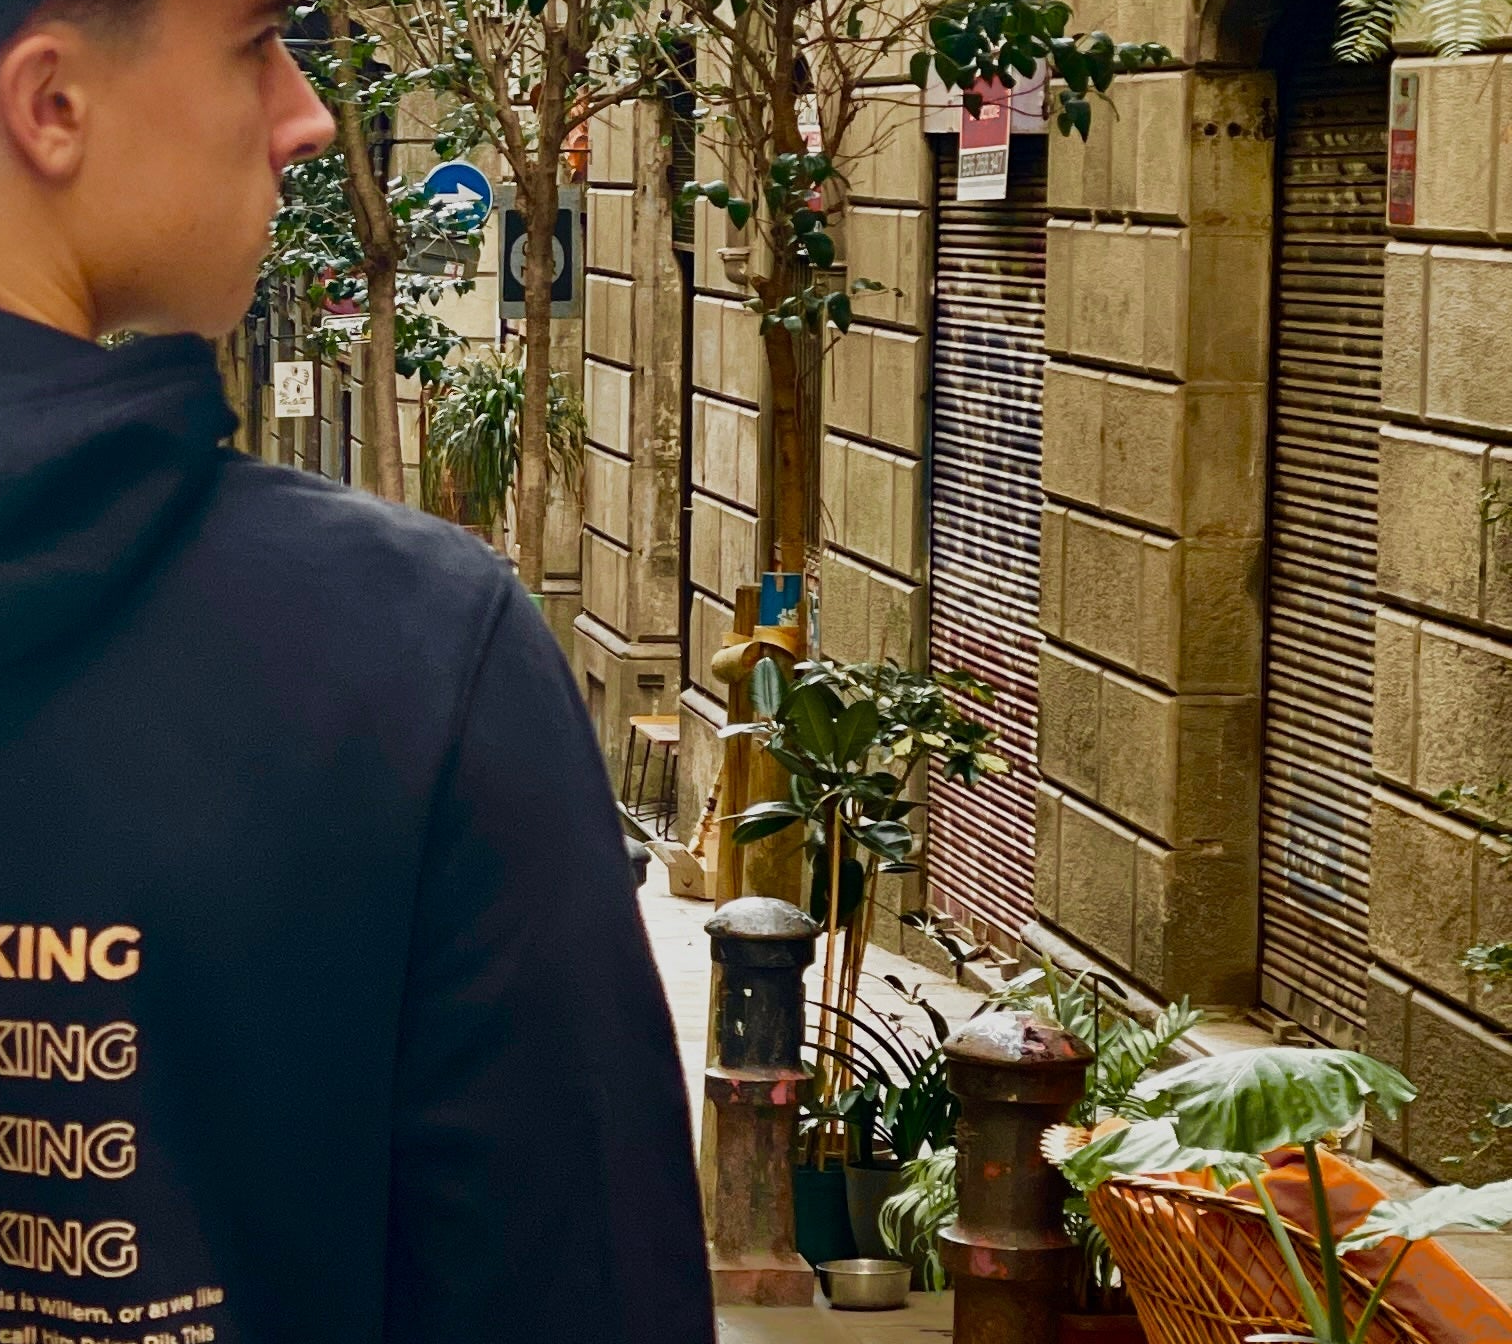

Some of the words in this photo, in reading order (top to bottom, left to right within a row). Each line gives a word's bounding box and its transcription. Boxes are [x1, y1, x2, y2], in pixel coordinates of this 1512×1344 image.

[20, 1292, 36, 1312] is
[118, 1306, 145, 1324] or
[168, 1294, 194, 1314] we
[195, 1287, 224, 1308] like
